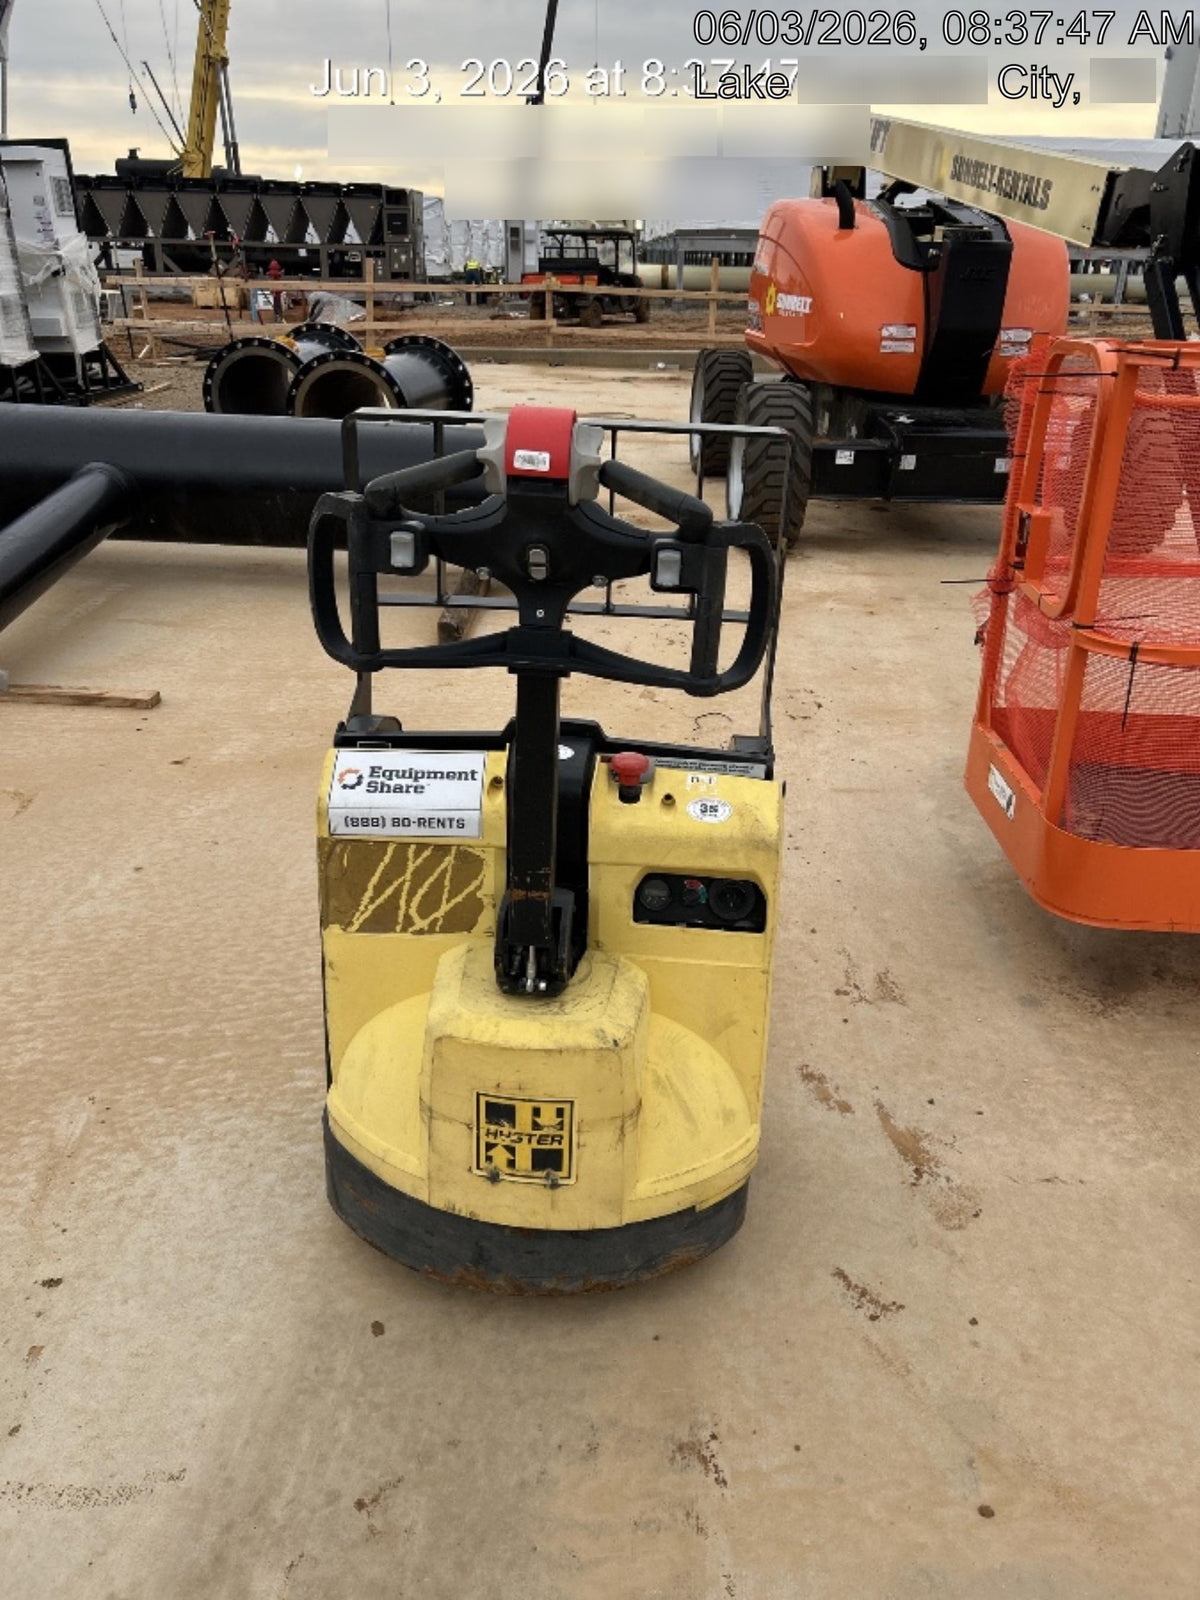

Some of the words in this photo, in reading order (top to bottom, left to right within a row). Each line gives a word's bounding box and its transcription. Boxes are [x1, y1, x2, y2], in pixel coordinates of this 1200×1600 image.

[368, 765, 479, 783] Equipment
[366, 780, 426, 795] Share
[344, 815, 387, 829] (888)
[485, 1126, 565, 1146] HYSTER
